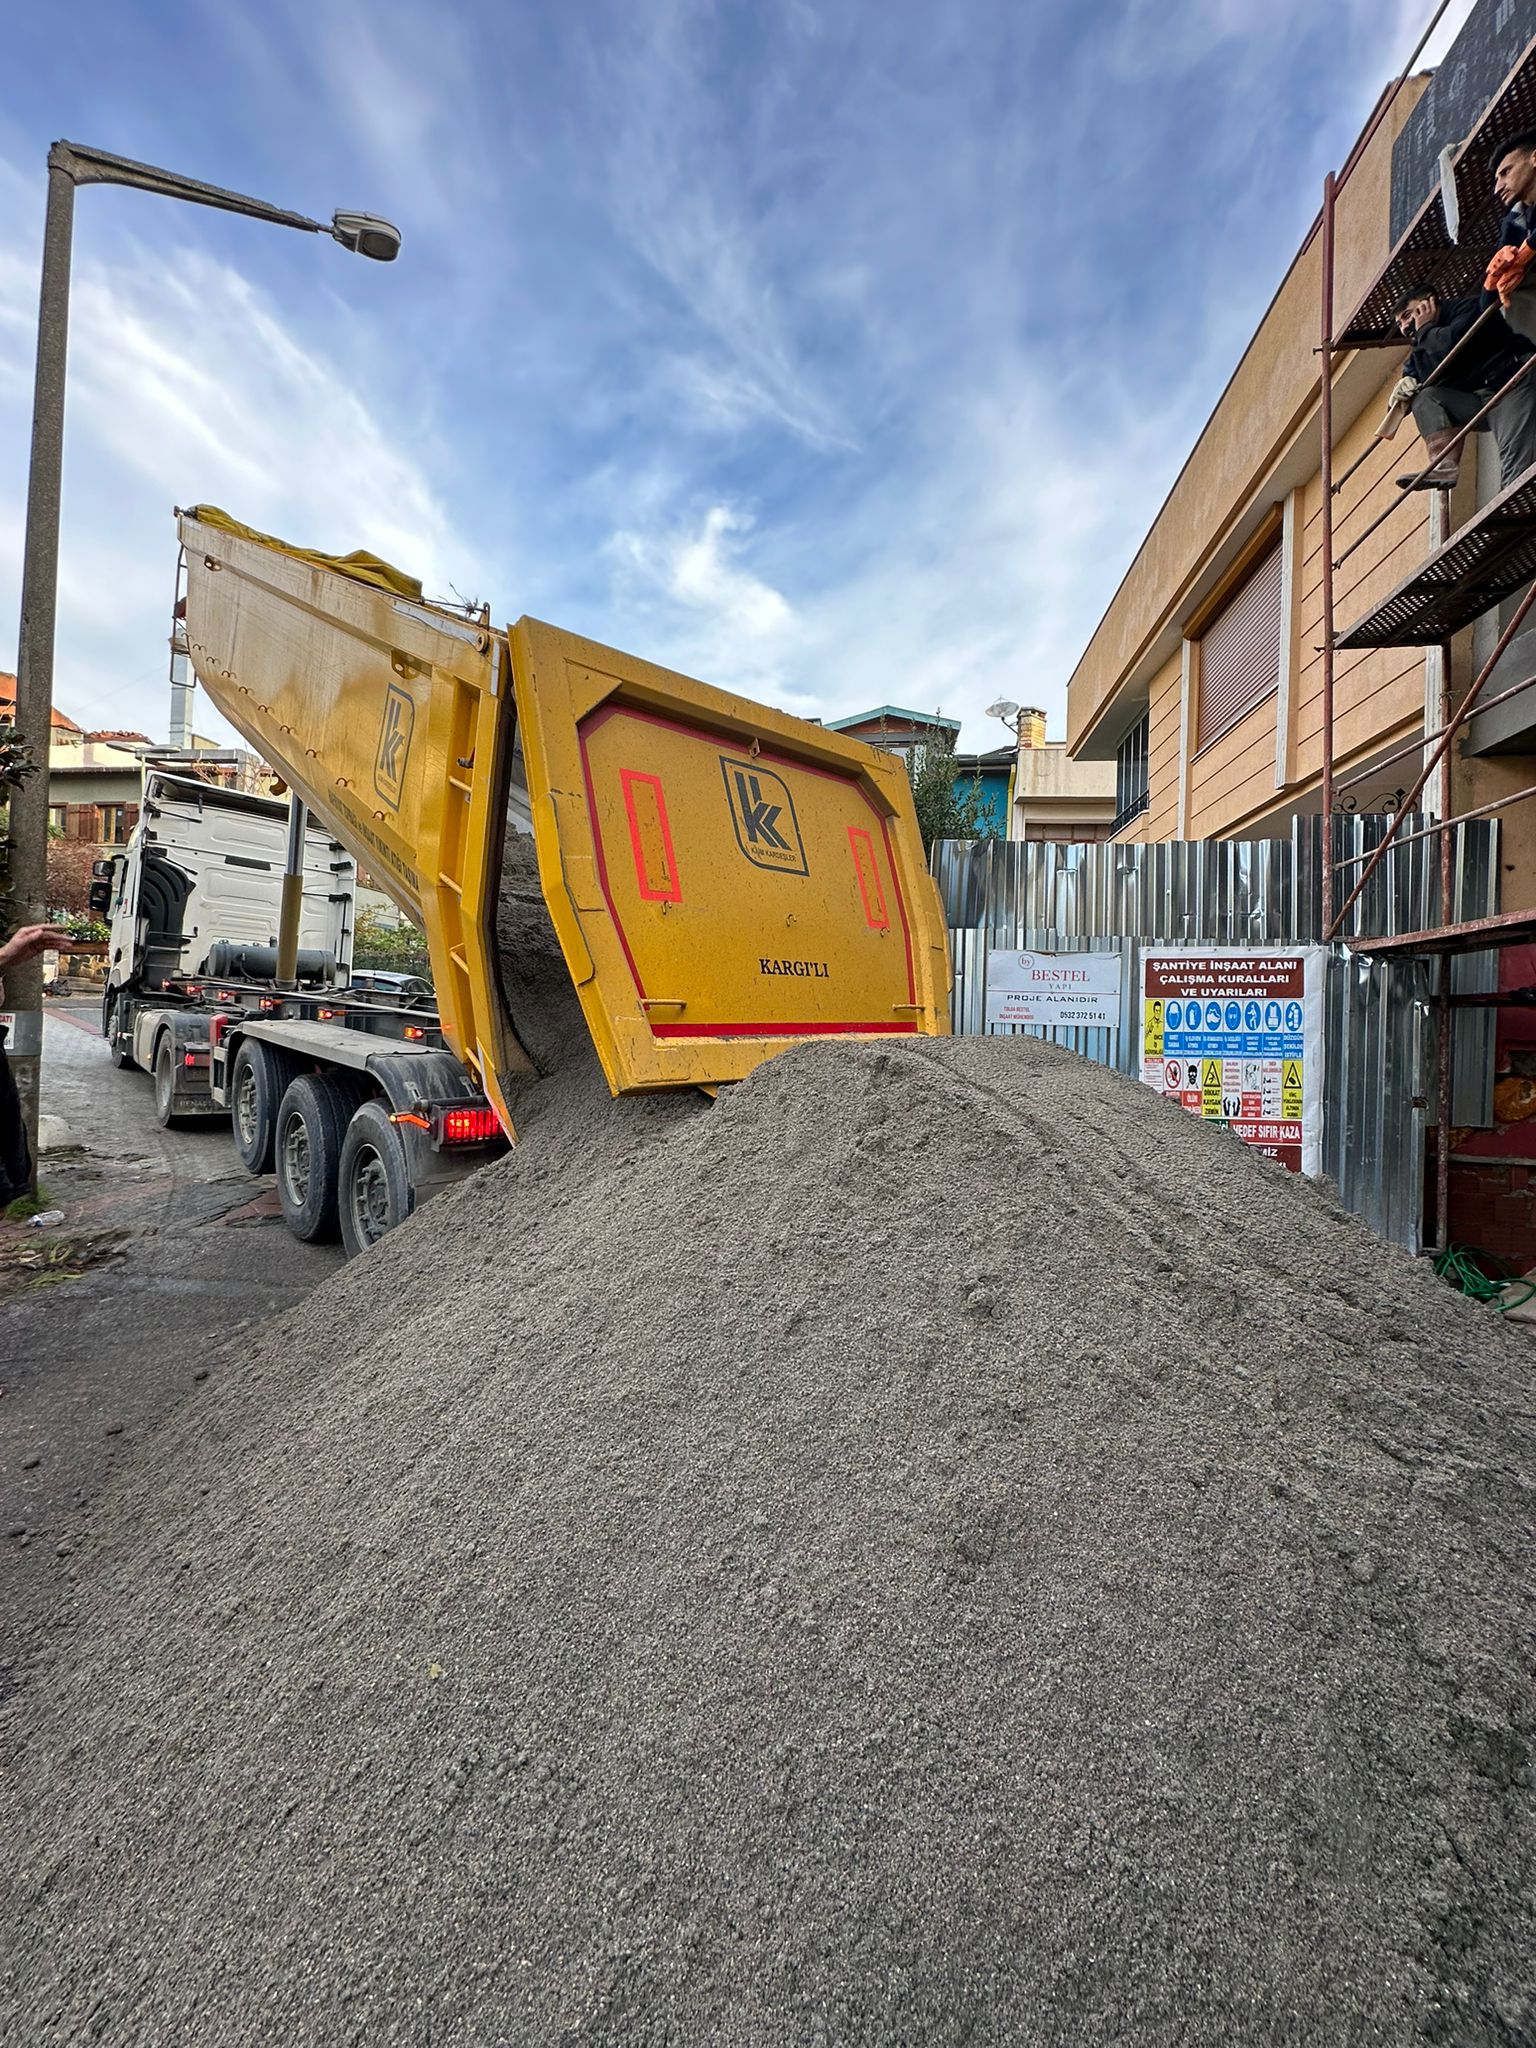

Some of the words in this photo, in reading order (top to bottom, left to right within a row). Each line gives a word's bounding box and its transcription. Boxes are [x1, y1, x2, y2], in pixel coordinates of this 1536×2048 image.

[758, 958, 829, 977] KARGI'LI
[1152, 960, 1207, 972] ŞANTİYE
[1210, 959, 1255, 972] İNŞAAT
[1258, 961, 1297, 970] ALANI
[1032, 969, 1090, 982] BESTEL
[1159, 975, 1215, 985] ÇALIŞMA
[1218, 974, 1290, 984] KURALLARI
[1007, 994, 1042, 1002] PROJE
[1046, 995, 1098, 1003] ALANIDIR
[1181, 988, 1197, 996] VE
[1201, 988, 1267, 997] UYARILARI
[1060, 1011, 1075, 1019] 0532
[1076, 1011, 1088, 1019] 372
[1097, 1012, 1106, 1020] 41
[1280, 1125, 1300, 1139] KAZA
